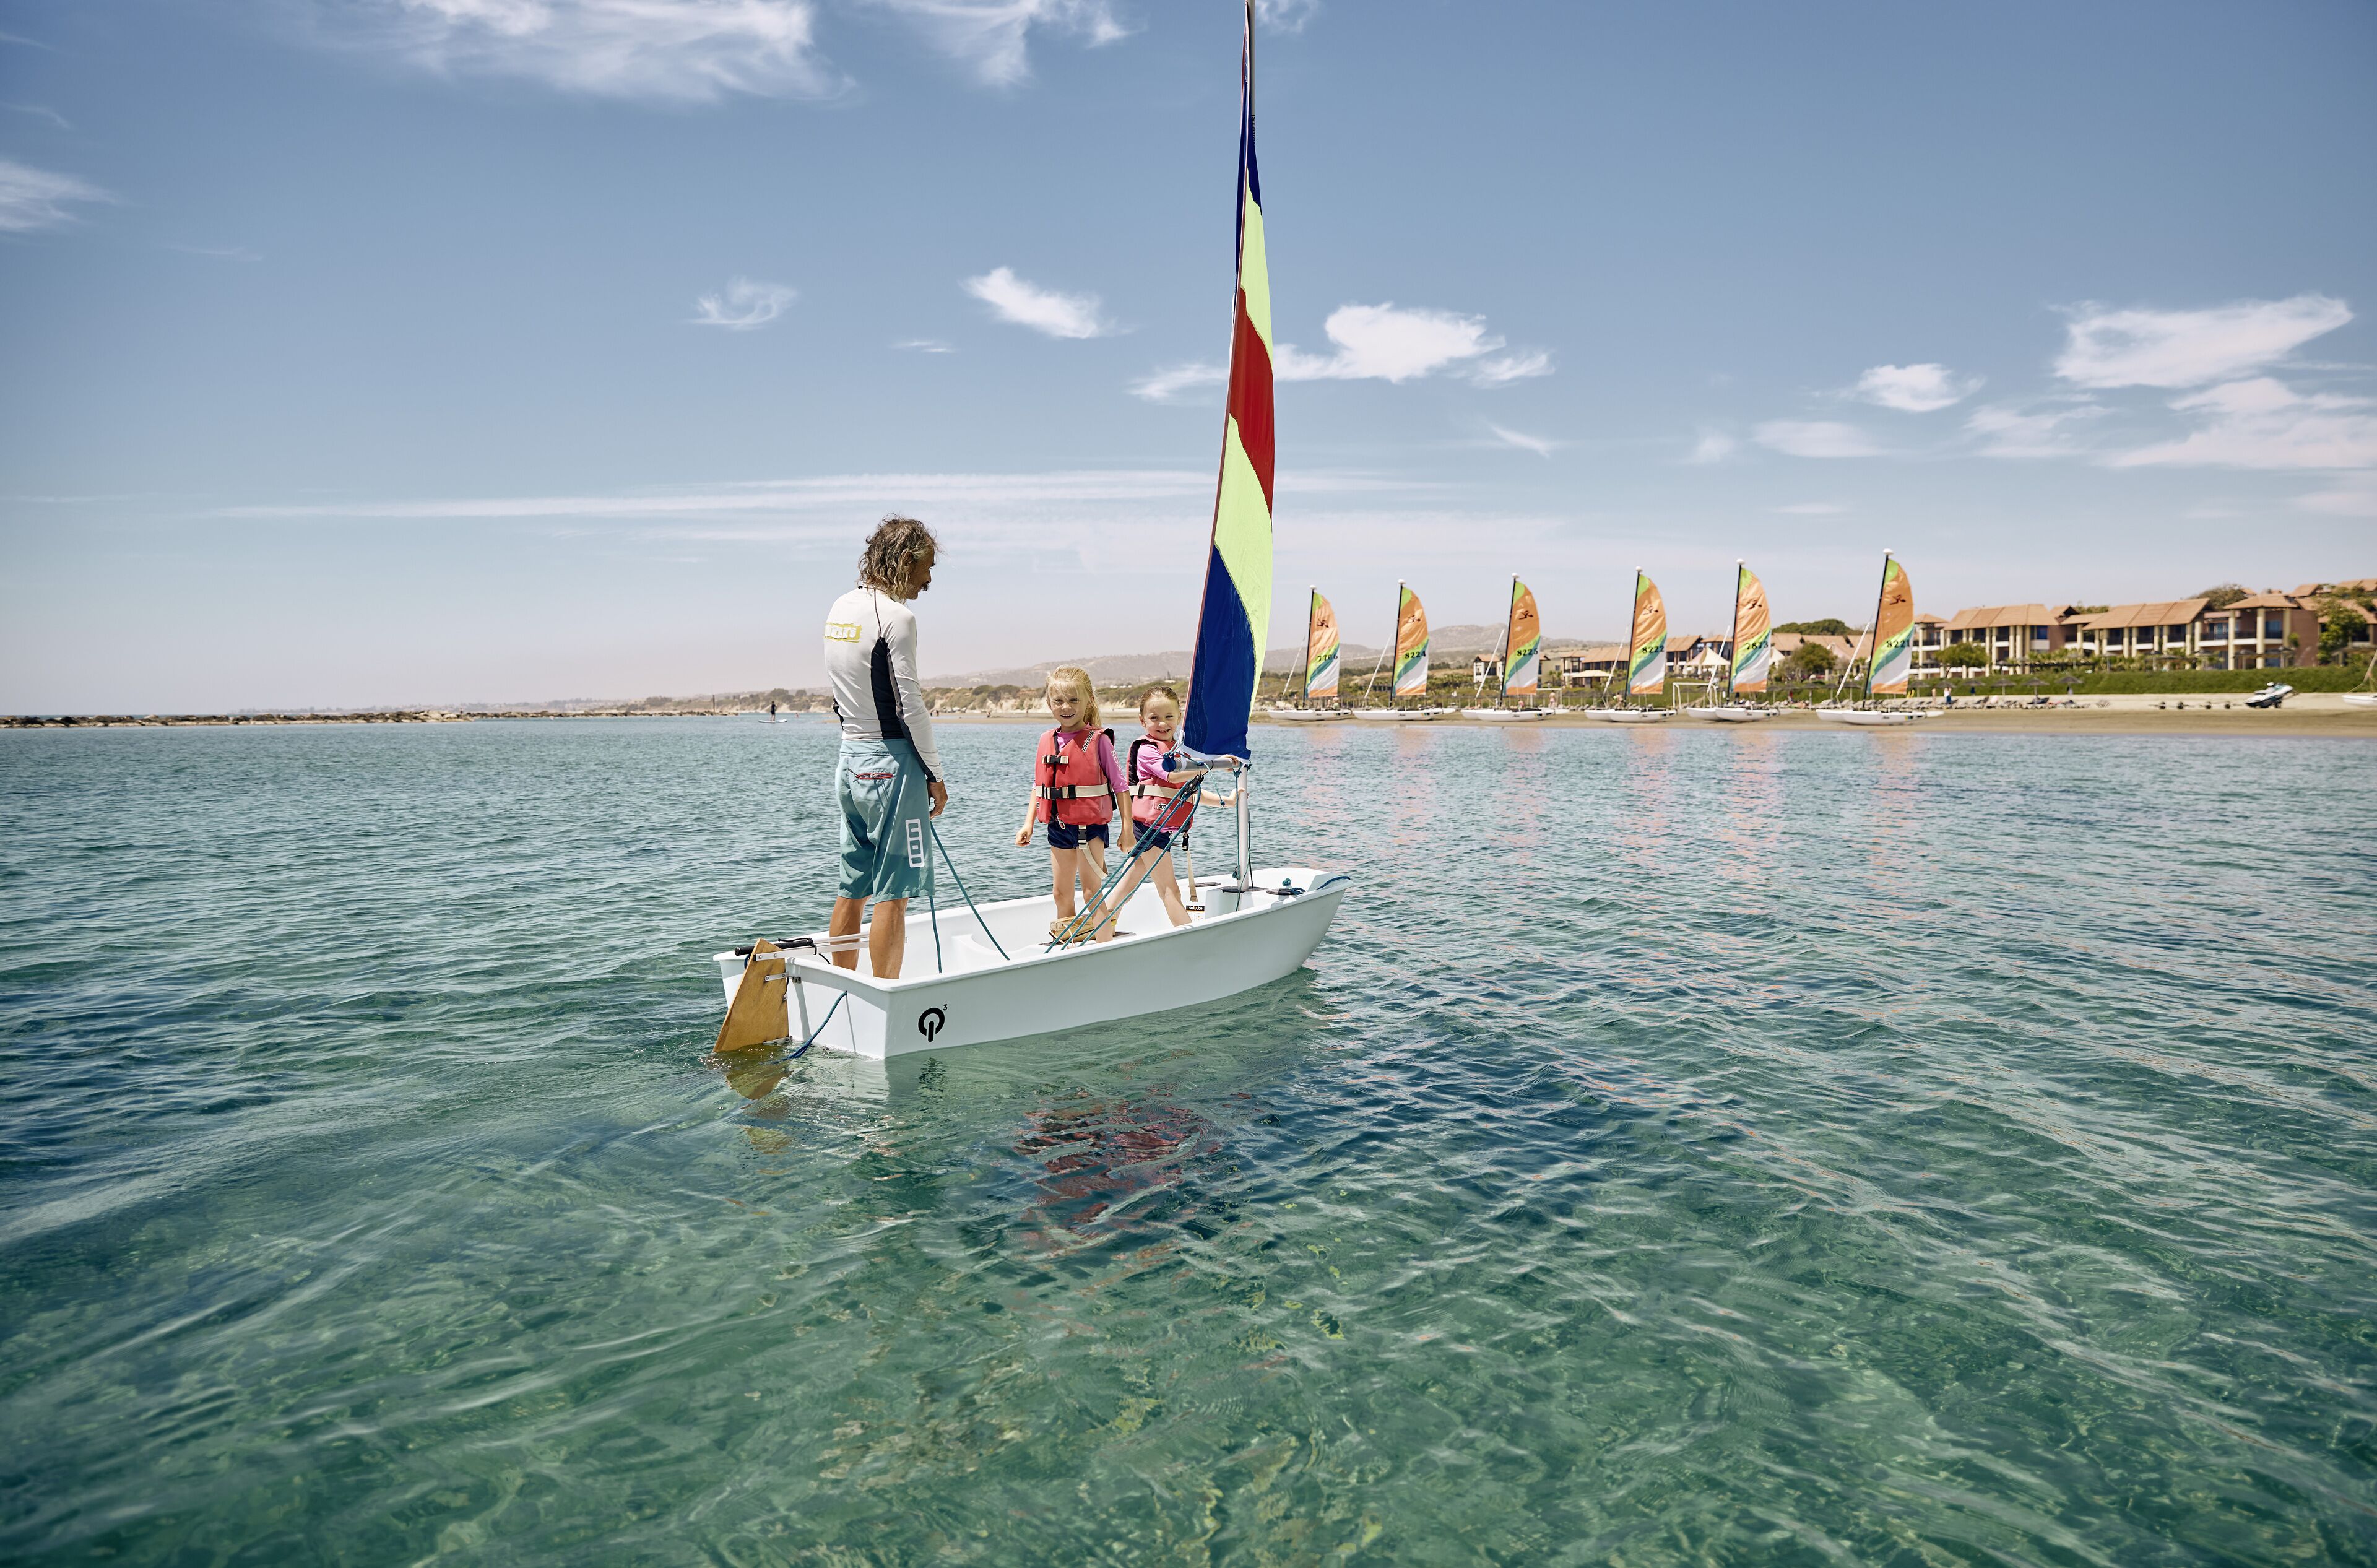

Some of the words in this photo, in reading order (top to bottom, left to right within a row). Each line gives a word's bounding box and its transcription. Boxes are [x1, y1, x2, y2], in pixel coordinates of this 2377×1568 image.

[1886, 639, 1910, 648] 8221
[1517, 648, 1538, 656] 8225
[1642, 645, 1665, 654] 8222
[1405, 651, 1426, 659] 8224
